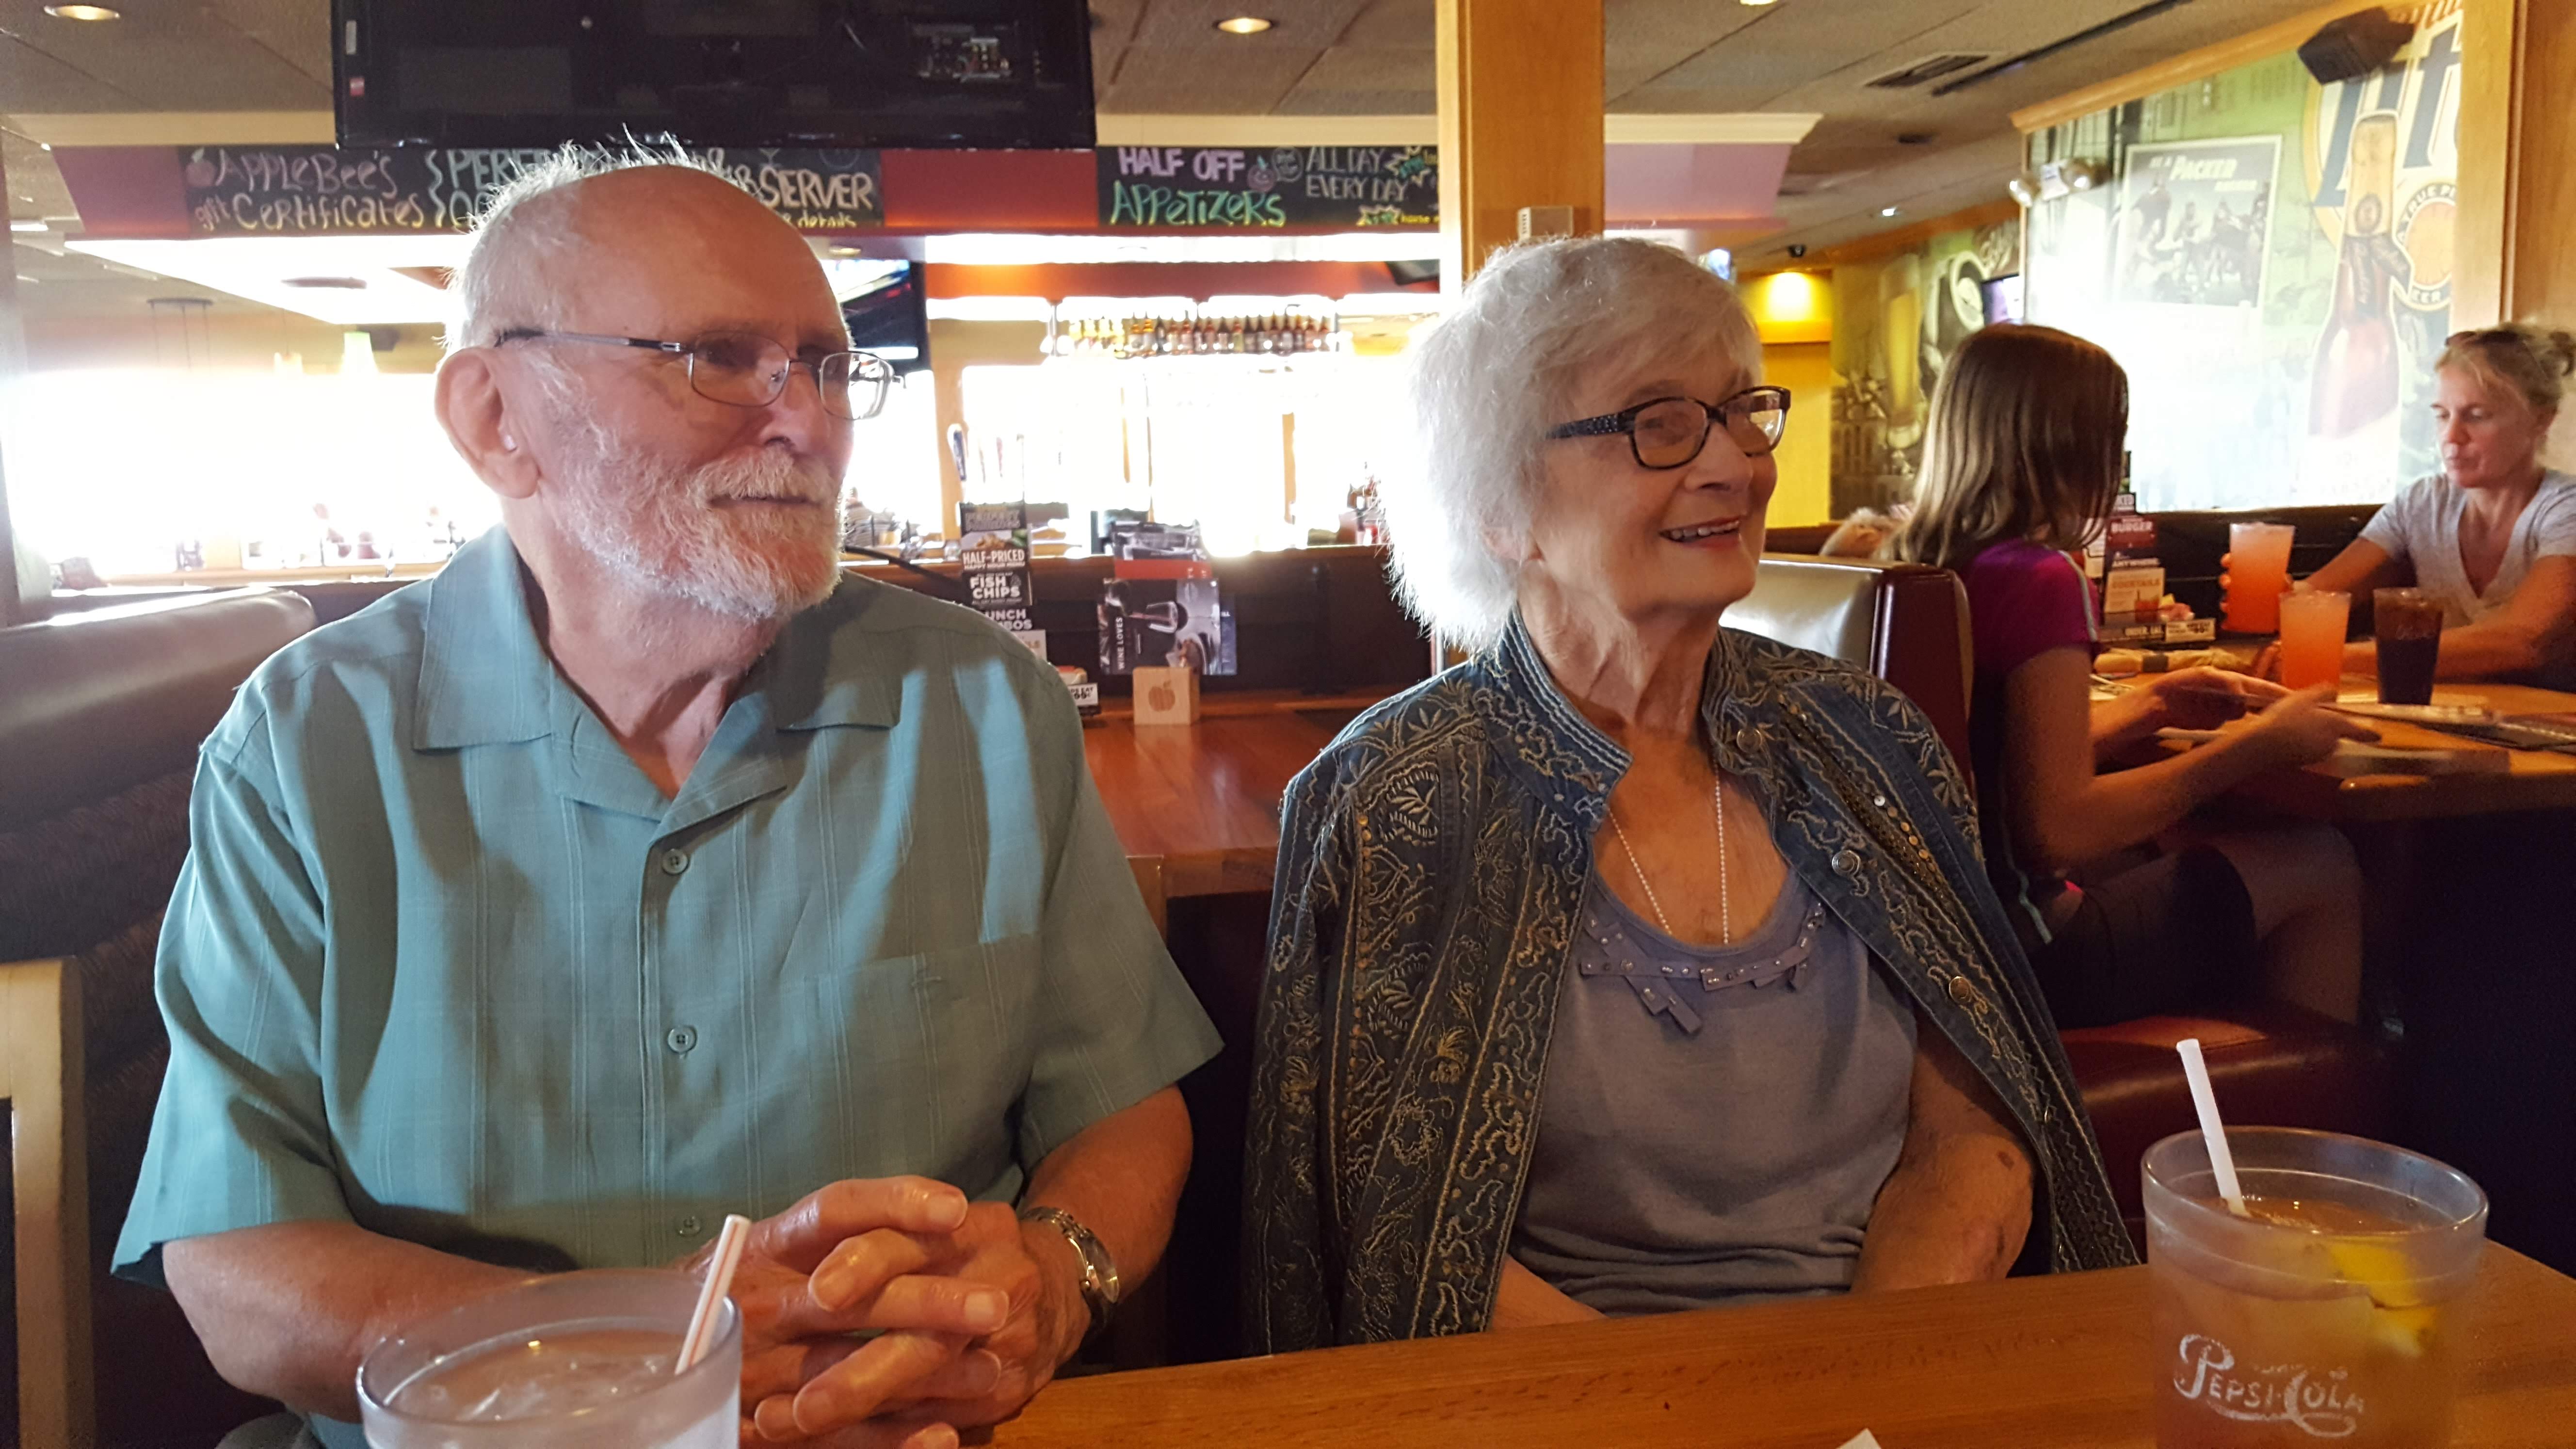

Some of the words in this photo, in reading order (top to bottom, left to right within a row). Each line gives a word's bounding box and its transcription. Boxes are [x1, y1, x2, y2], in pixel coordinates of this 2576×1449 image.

[1117, 146, 1185, 177] HALF
[1192, 148, 1245, 182] OFF
[1306, 146, 1345, 172] ALL
[1348, 147, 1385, 173] DAY
[2169, 155, 2238, 181] PACKER
[759, 165, 873, 210] SERVER
[1306, 174, 1368, 199] EVERY
[1371, 177, 1407, 201] DAY
[2111, 520, 2153, 533] BURGER
[962, 549, 1025, 564] HALF-PRICED
[970, 576, 1007, 590] FISH
[972, 585, 1020, 600] CHIPS
[984, 608, 1026, 621] UNCH
[1116, 617, 1124, 645] LOVES
